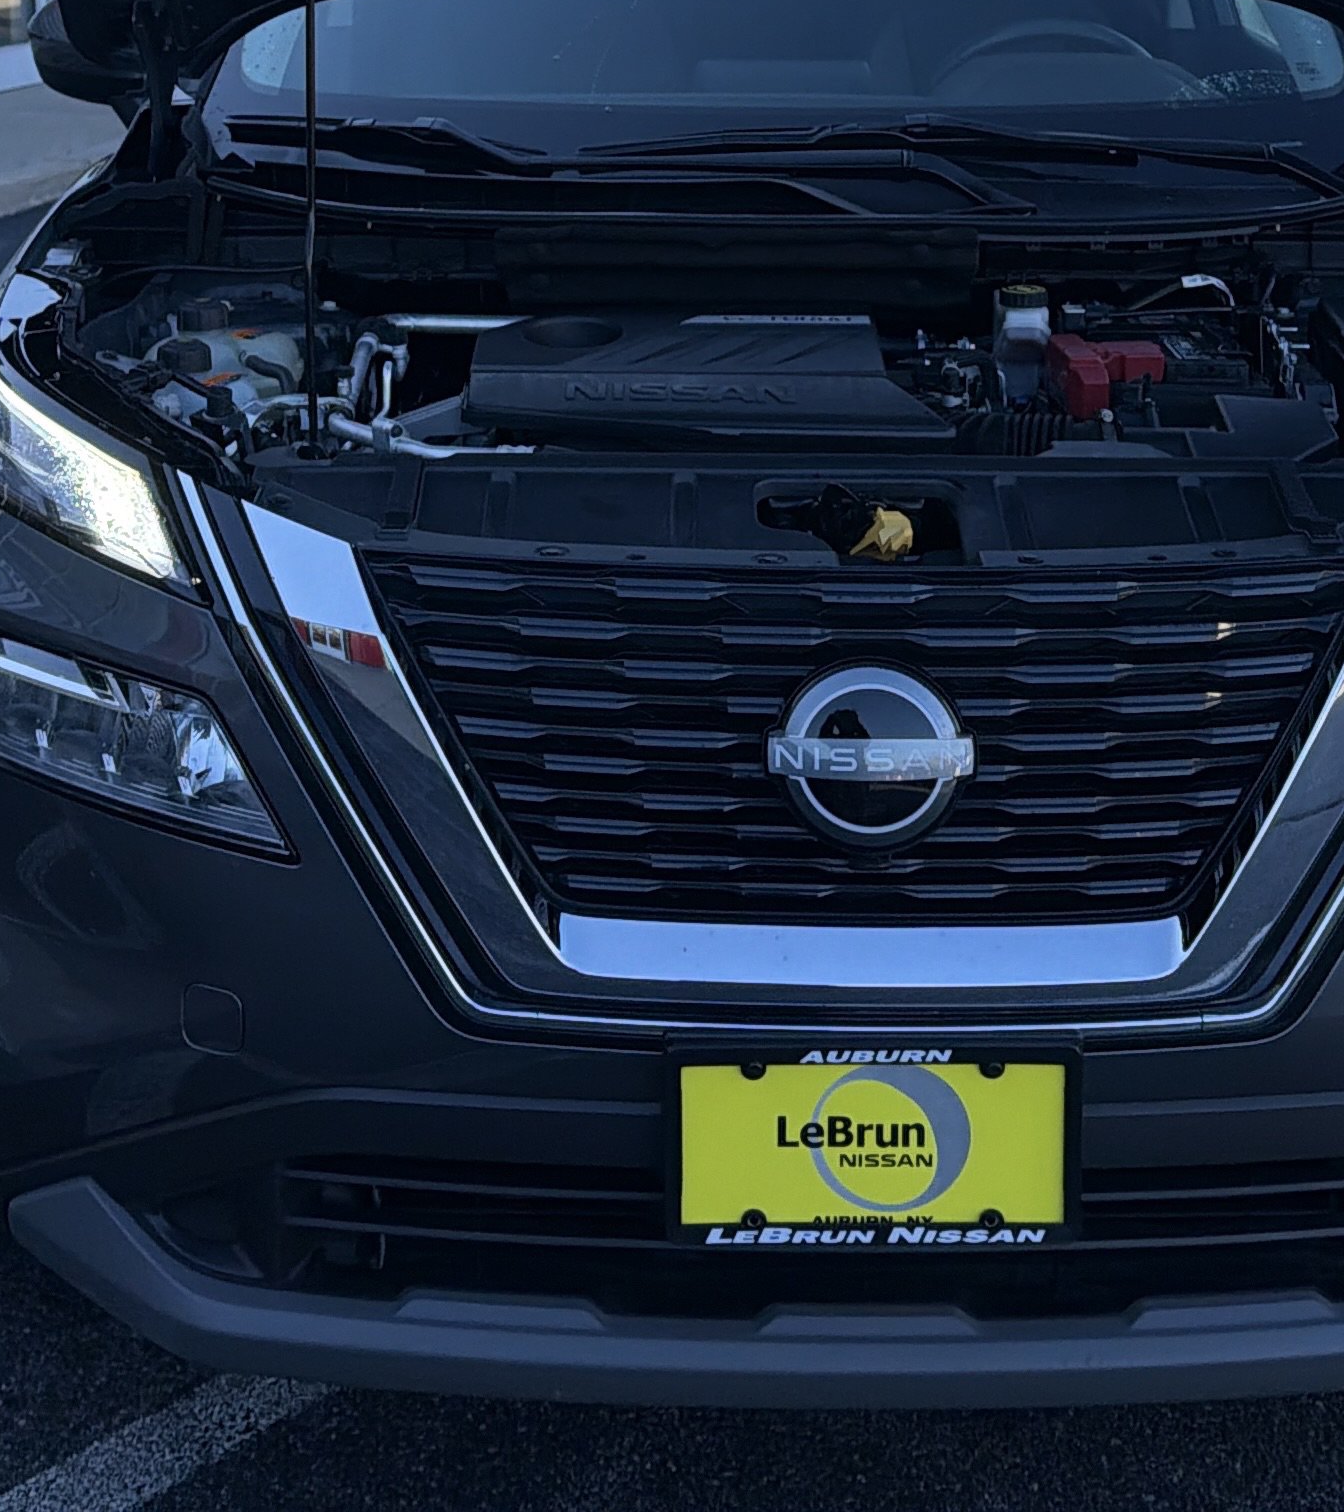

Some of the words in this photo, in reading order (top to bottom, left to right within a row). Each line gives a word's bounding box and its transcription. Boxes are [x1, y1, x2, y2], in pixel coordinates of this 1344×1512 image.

[565, 380, 796, 405] NISSAN
[773, 743, 967, 773] NISSAN
[800, 1050, 953, 1064] AUBURN
[776, 1115, 926, 1148] LeBrun
[839, 1154, 934, 1168] NISSAN
